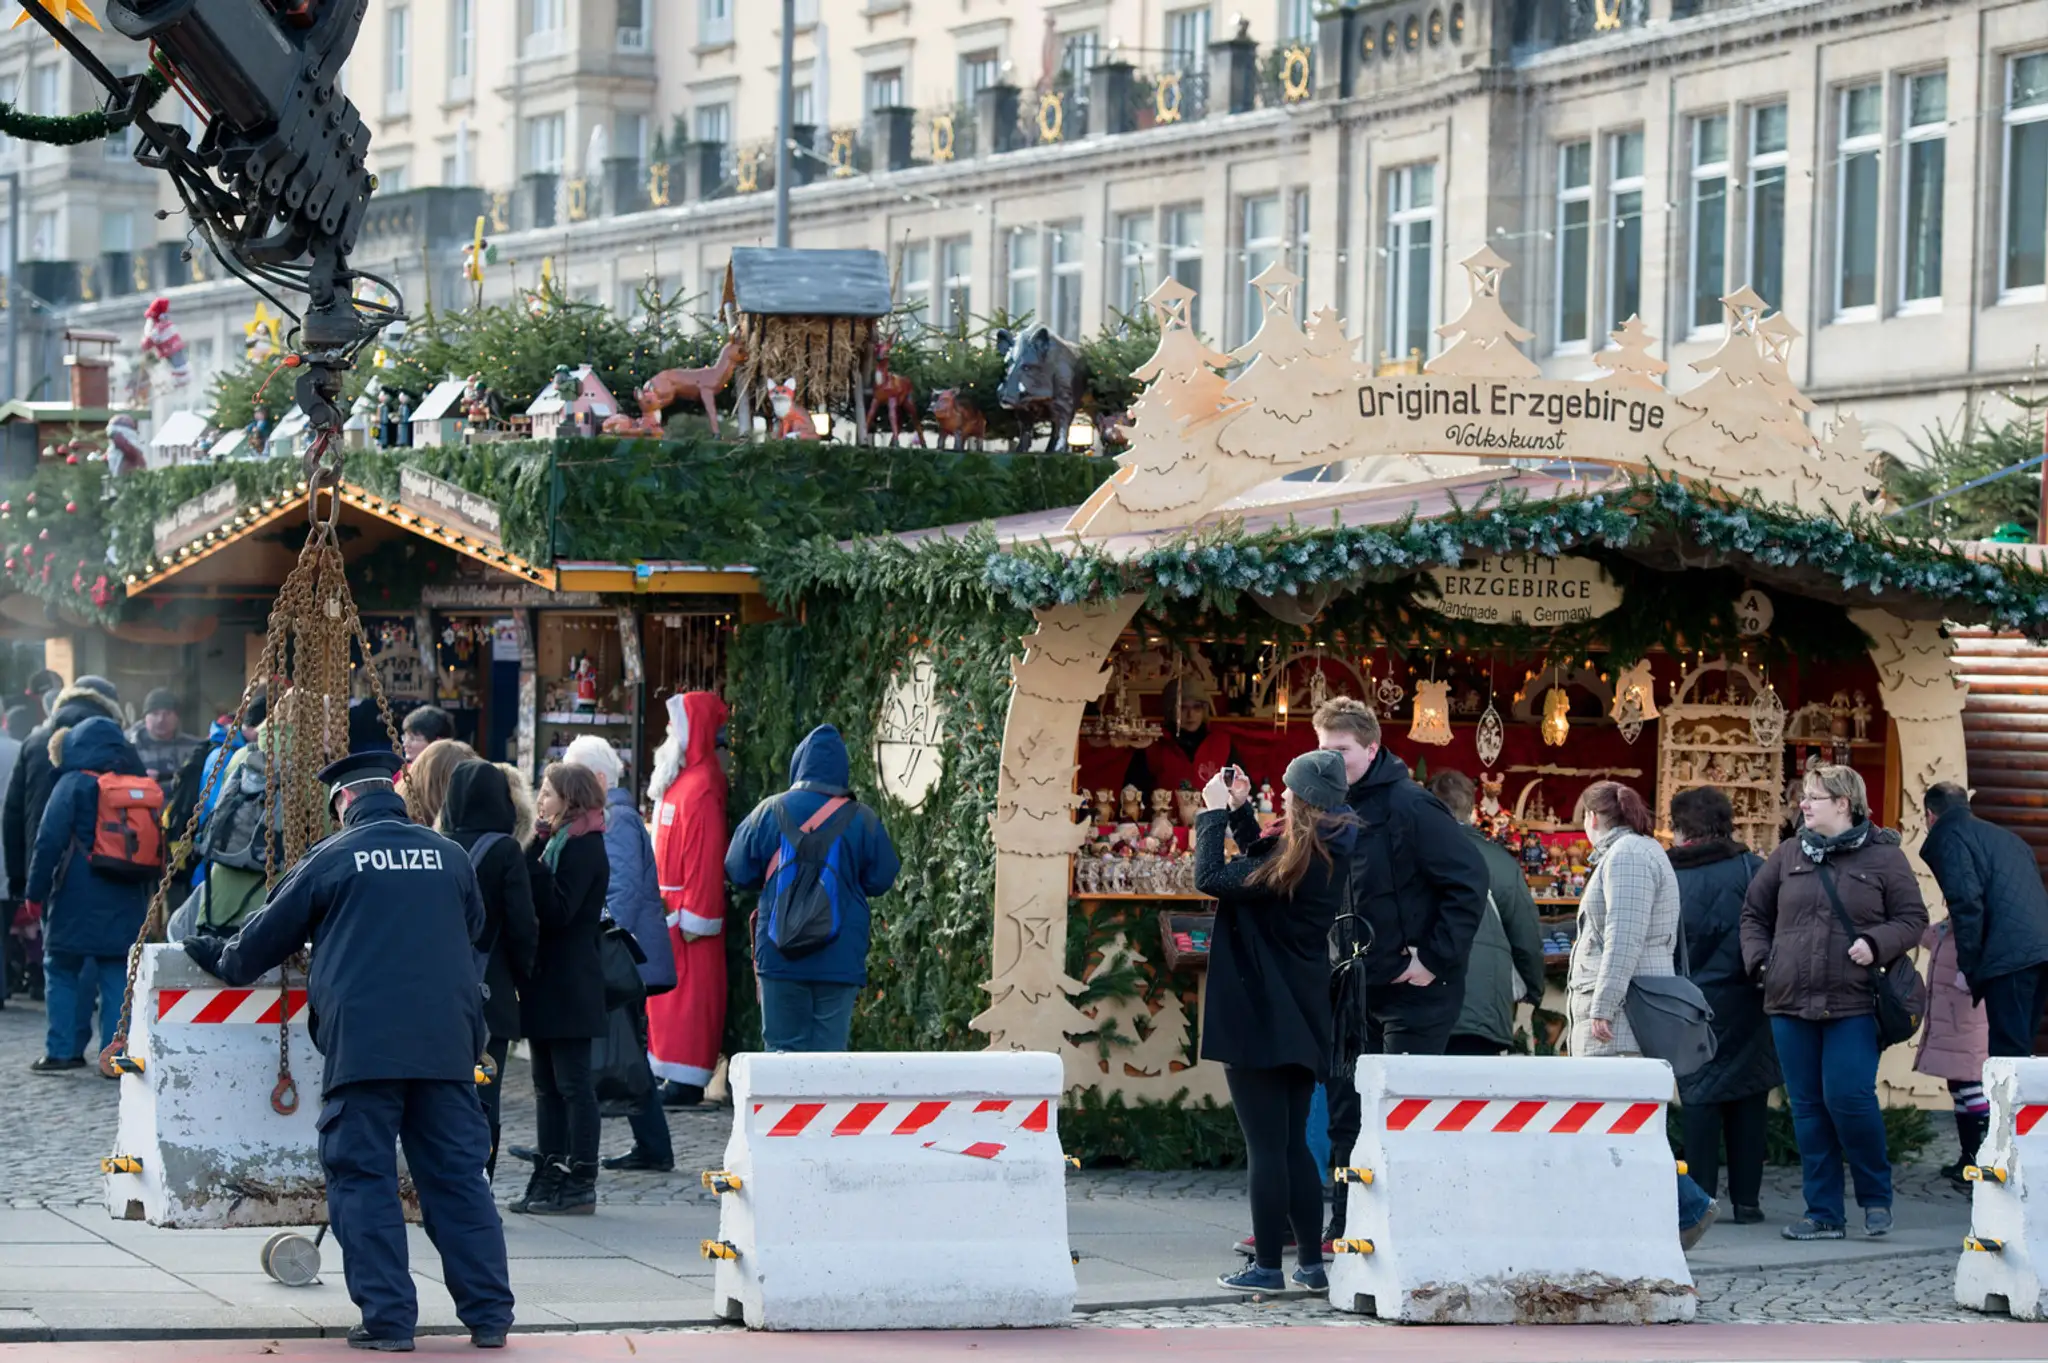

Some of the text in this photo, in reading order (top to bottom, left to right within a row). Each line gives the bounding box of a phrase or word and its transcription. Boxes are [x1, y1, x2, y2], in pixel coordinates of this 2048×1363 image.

[1358, 382, 1665, 433] Original Erzgebirge
[1445, 422, 1567, 450] Volkskunst
[1481, 555, 1560, 575] ECHT
[1445, 576, 1591, 599] ERZGEBIRGE
[1437, 599, 1593, 622] handmade in Germany
[1744, 595, 1760, 612] A
[353, 848, 444, 873] POLIZEI
